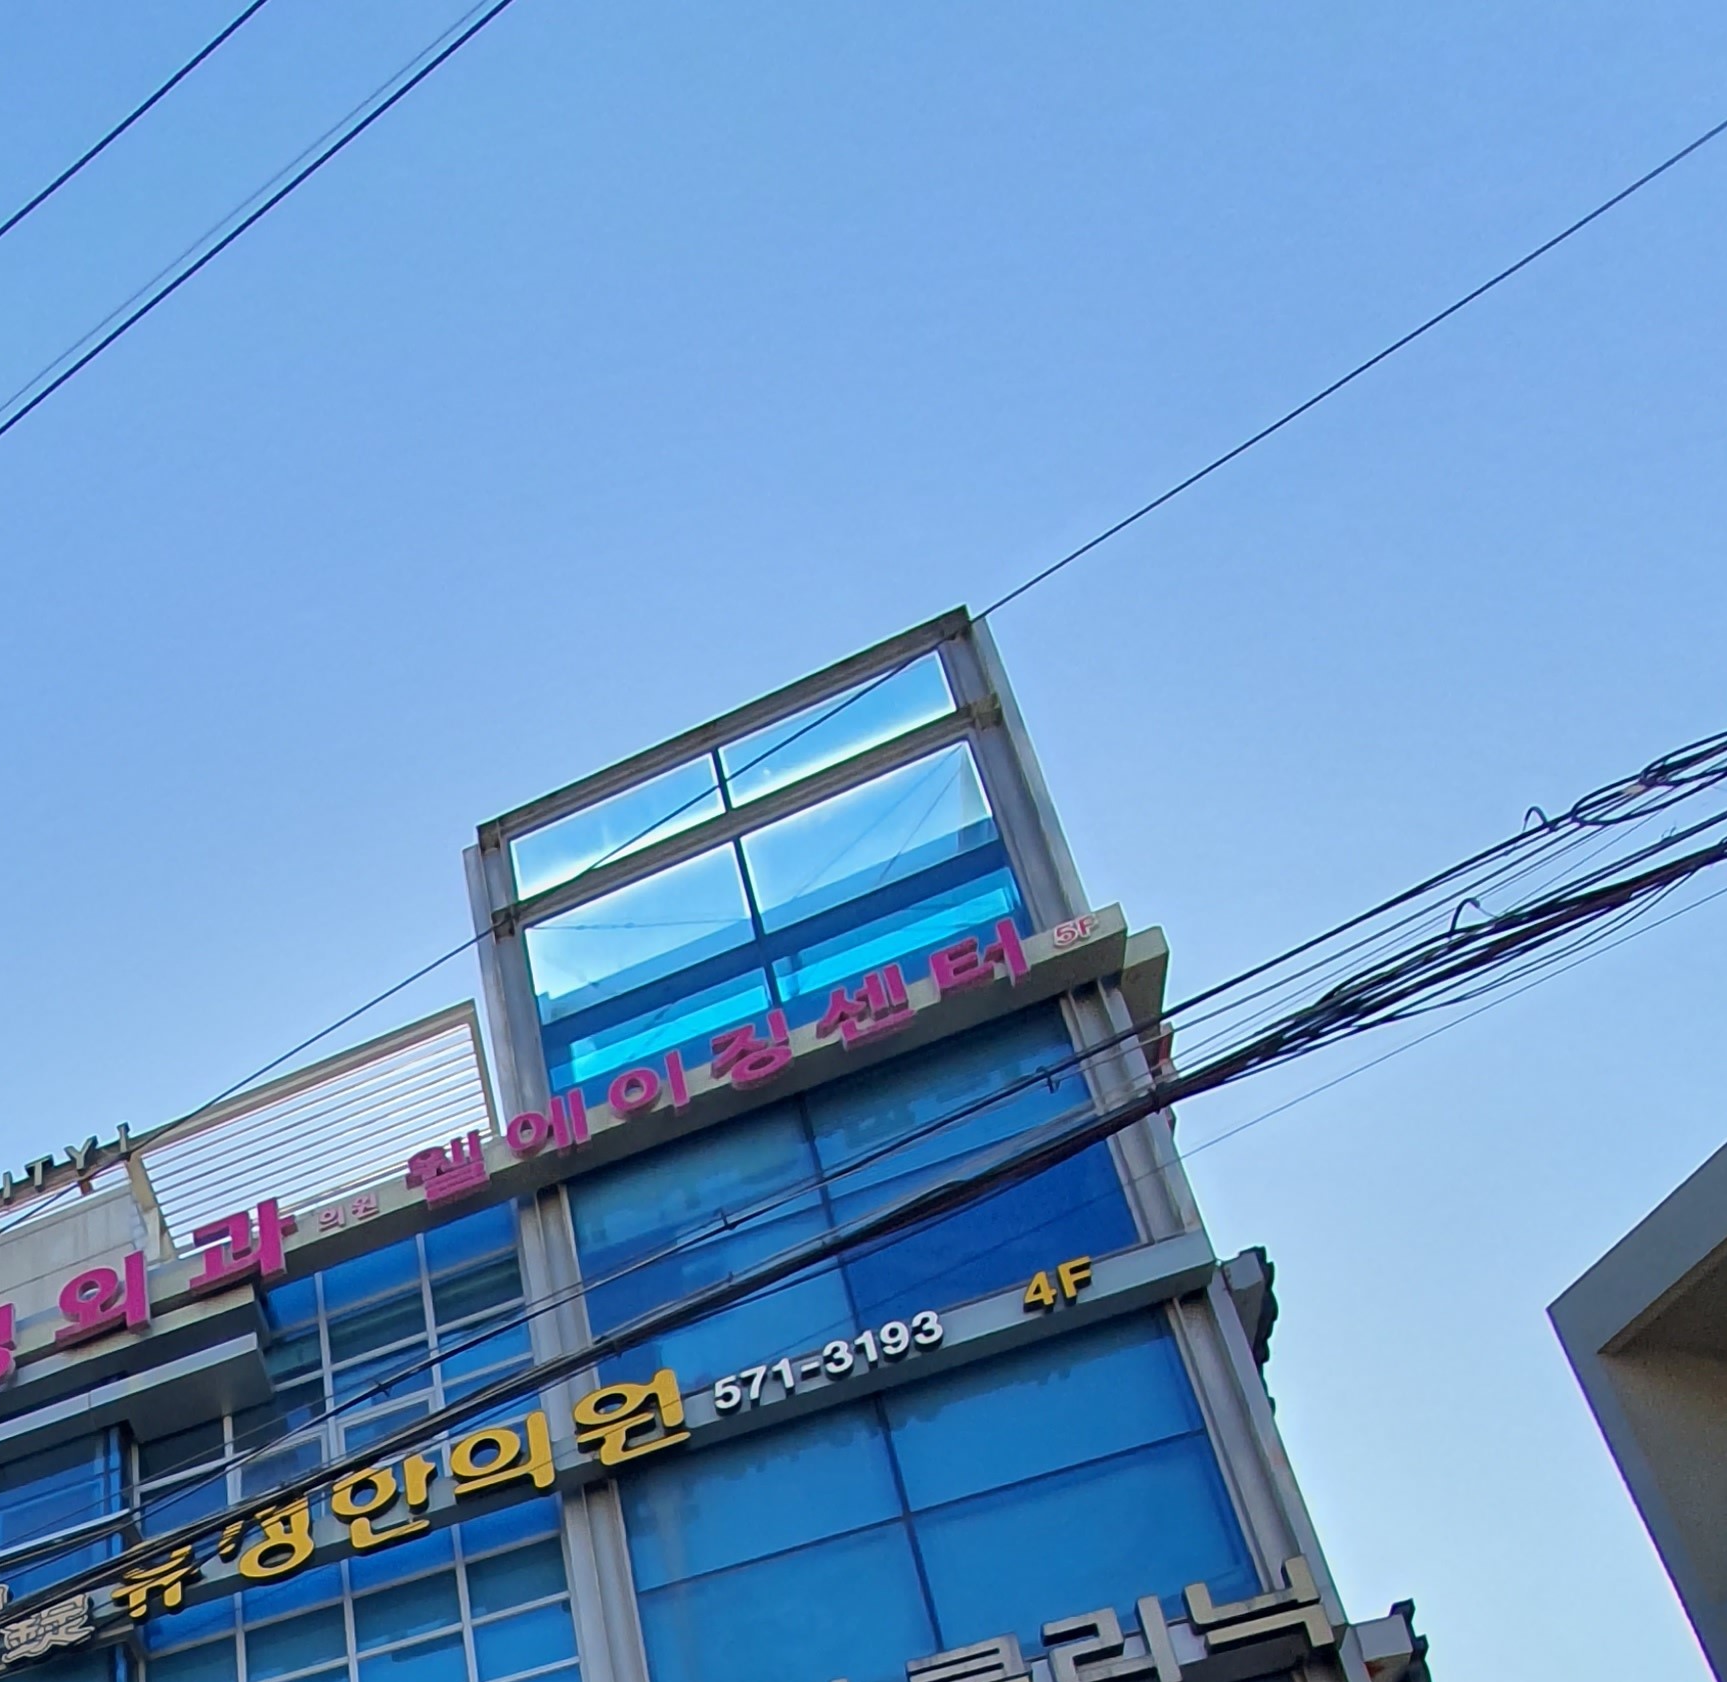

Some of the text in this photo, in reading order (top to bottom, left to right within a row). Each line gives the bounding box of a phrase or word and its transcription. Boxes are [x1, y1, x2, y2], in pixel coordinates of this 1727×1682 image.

[403, 919, 1032, 1208] 웰에이징센터
[713, 1309, 944, 1416] 571-3193
[1022, 1256, 1092, 1317] 4F
